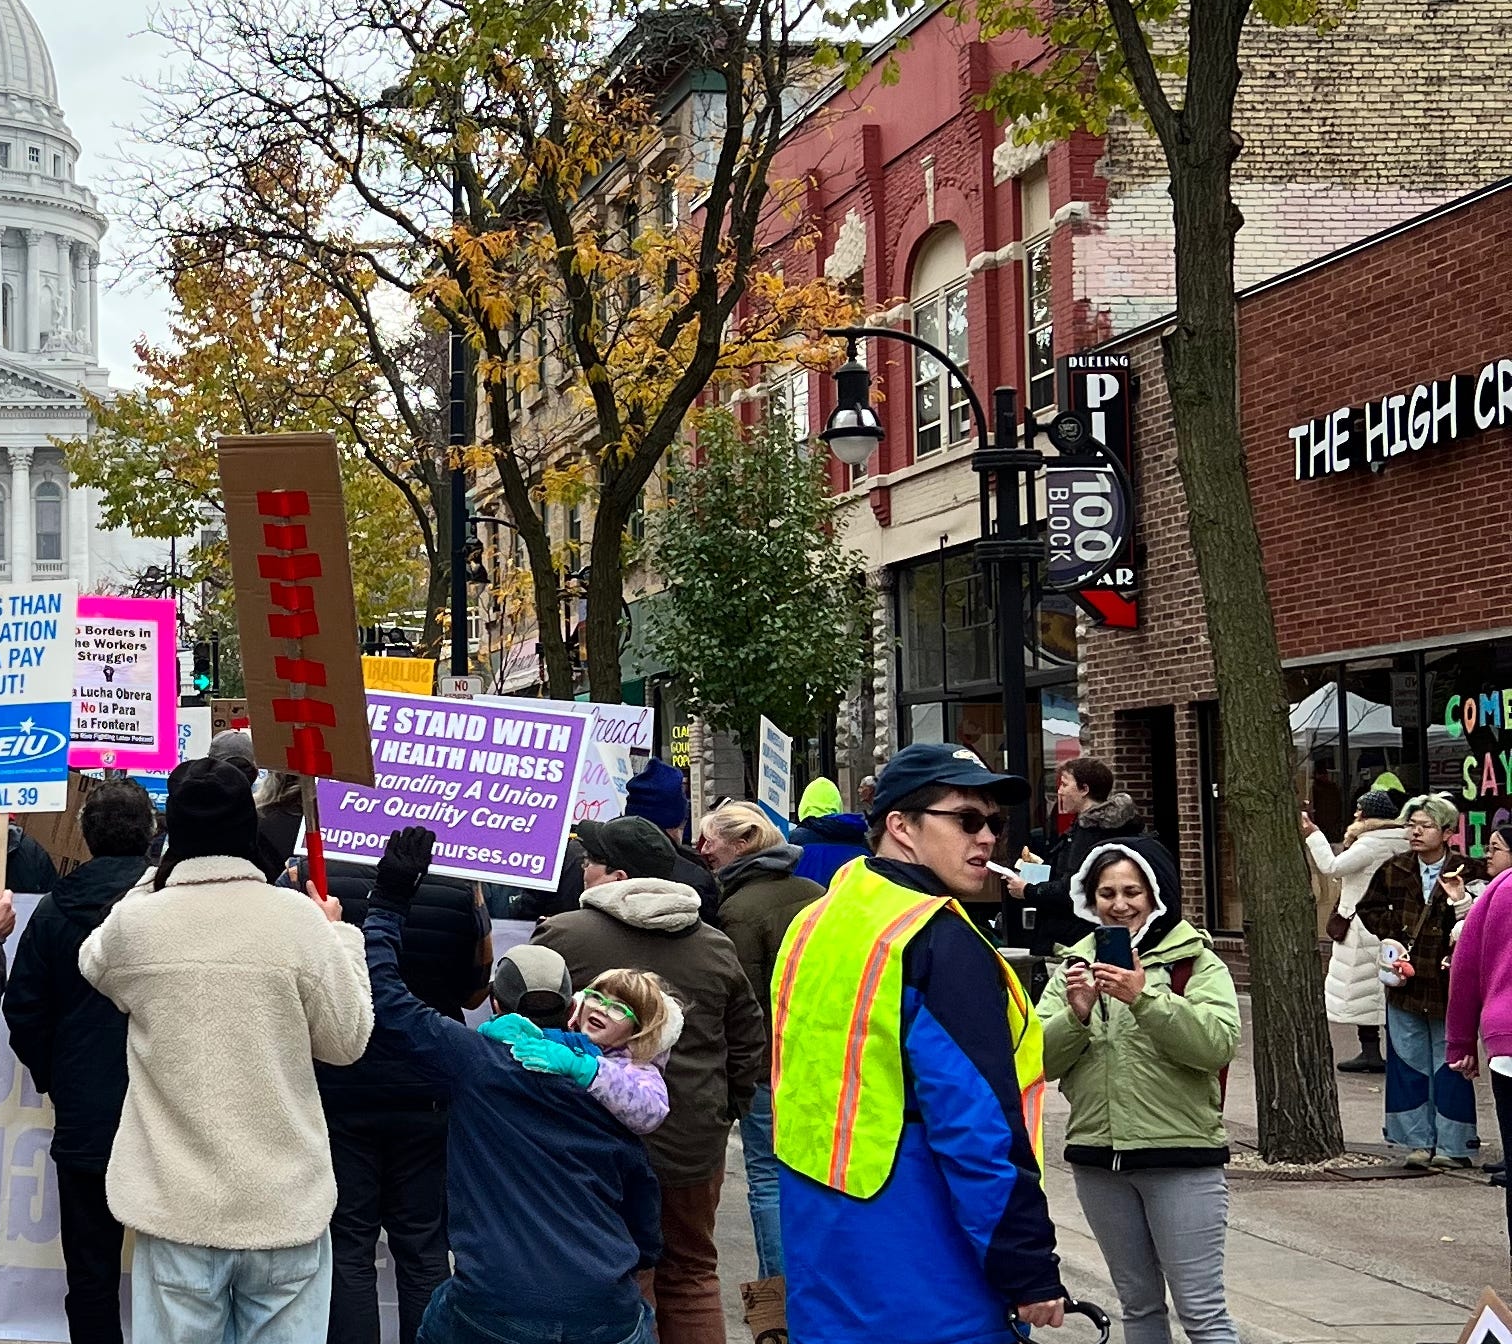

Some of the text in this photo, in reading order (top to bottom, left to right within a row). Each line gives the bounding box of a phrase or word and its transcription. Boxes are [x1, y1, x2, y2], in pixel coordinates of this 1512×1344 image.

[1068, 356, 1129, 369] DUELING
[1288, 407, 1351, 481] THE
[1365, 374, 1457, 463] HIGH
[1048, 486, 1072, 562] BLOCK
[1072, 472, 1114, 562] 100
[1079, 567, 1134, 587] AR
[8, 593, 62, 616] THAN
[85, 625, 136, 638] Borders
[139, 628, 151, 638] in
[74, 638, 148, 651] he Workers
[8, 646, 46, 669] PAY
[77, 651, 138, 665] Struggle!
[80, 686, 113, 699] Lucha
[116, 688, 152, 701] Obrera
[454, 680, 468, 692] NO
[81, 702, 136, 716] No la Para
[1444, 688, 1512, 738] COME
[77, 717, 140, 732] la Frontera!
[394, 706, 487, 743] STAND
[491, 717, 572, 753] WITH
[380, 741, 466, 772] HEALTH
[469, 750, 565, 784] NURSES
[17, 787, 39, 806] 39
[375, 772, 558, 810] anding A Union
[339, 790, 538, 834] For Quality Care!
[319, 826, 546, 875] suppornurses.org
